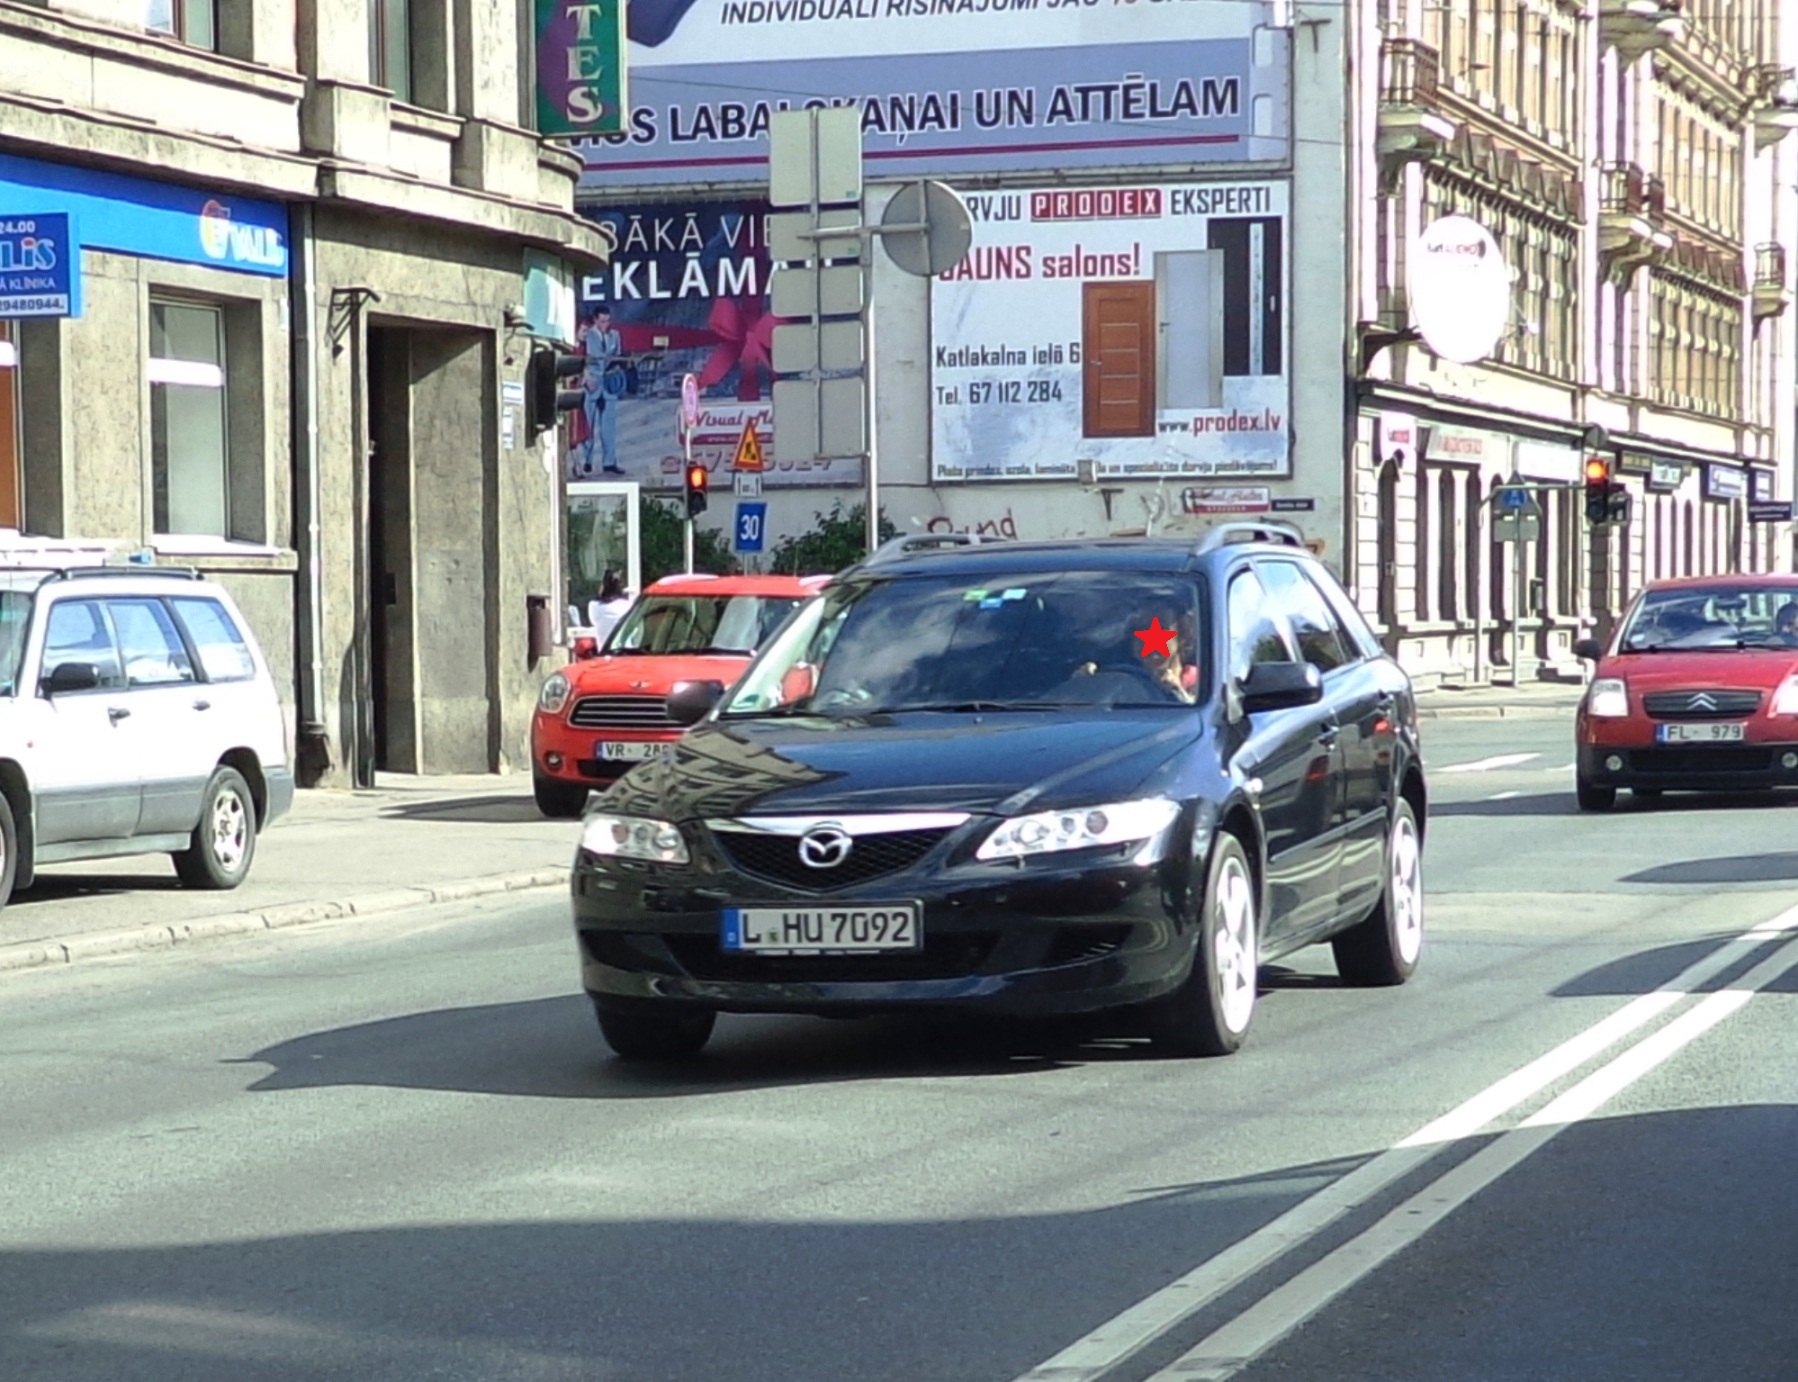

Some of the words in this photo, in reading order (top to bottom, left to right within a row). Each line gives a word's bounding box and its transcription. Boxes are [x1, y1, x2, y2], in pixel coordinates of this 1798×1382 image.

[974, 89, 1035, 128] UN
[1046, 74, 1239, 125] ATTĒLAM
[1034, 191, 1158, 217] PRODEX
[1171, 187, 1271, 215] EKSPERTI
[1042, 242, 1140, 279] salons!
[936, 343, 1027, 368] Katlakalna
[1069, 342, 1081, 363] 6
[969, 382, 992, 404] 67
[998, 381, 1021, 404] 112
[1028, 380, 1062, 403] 284
[1158, 407, 1281, 437] www.prodex.lv
[740, 514, 760, 540] 30
[1711, 724, 1741, 739] 979
